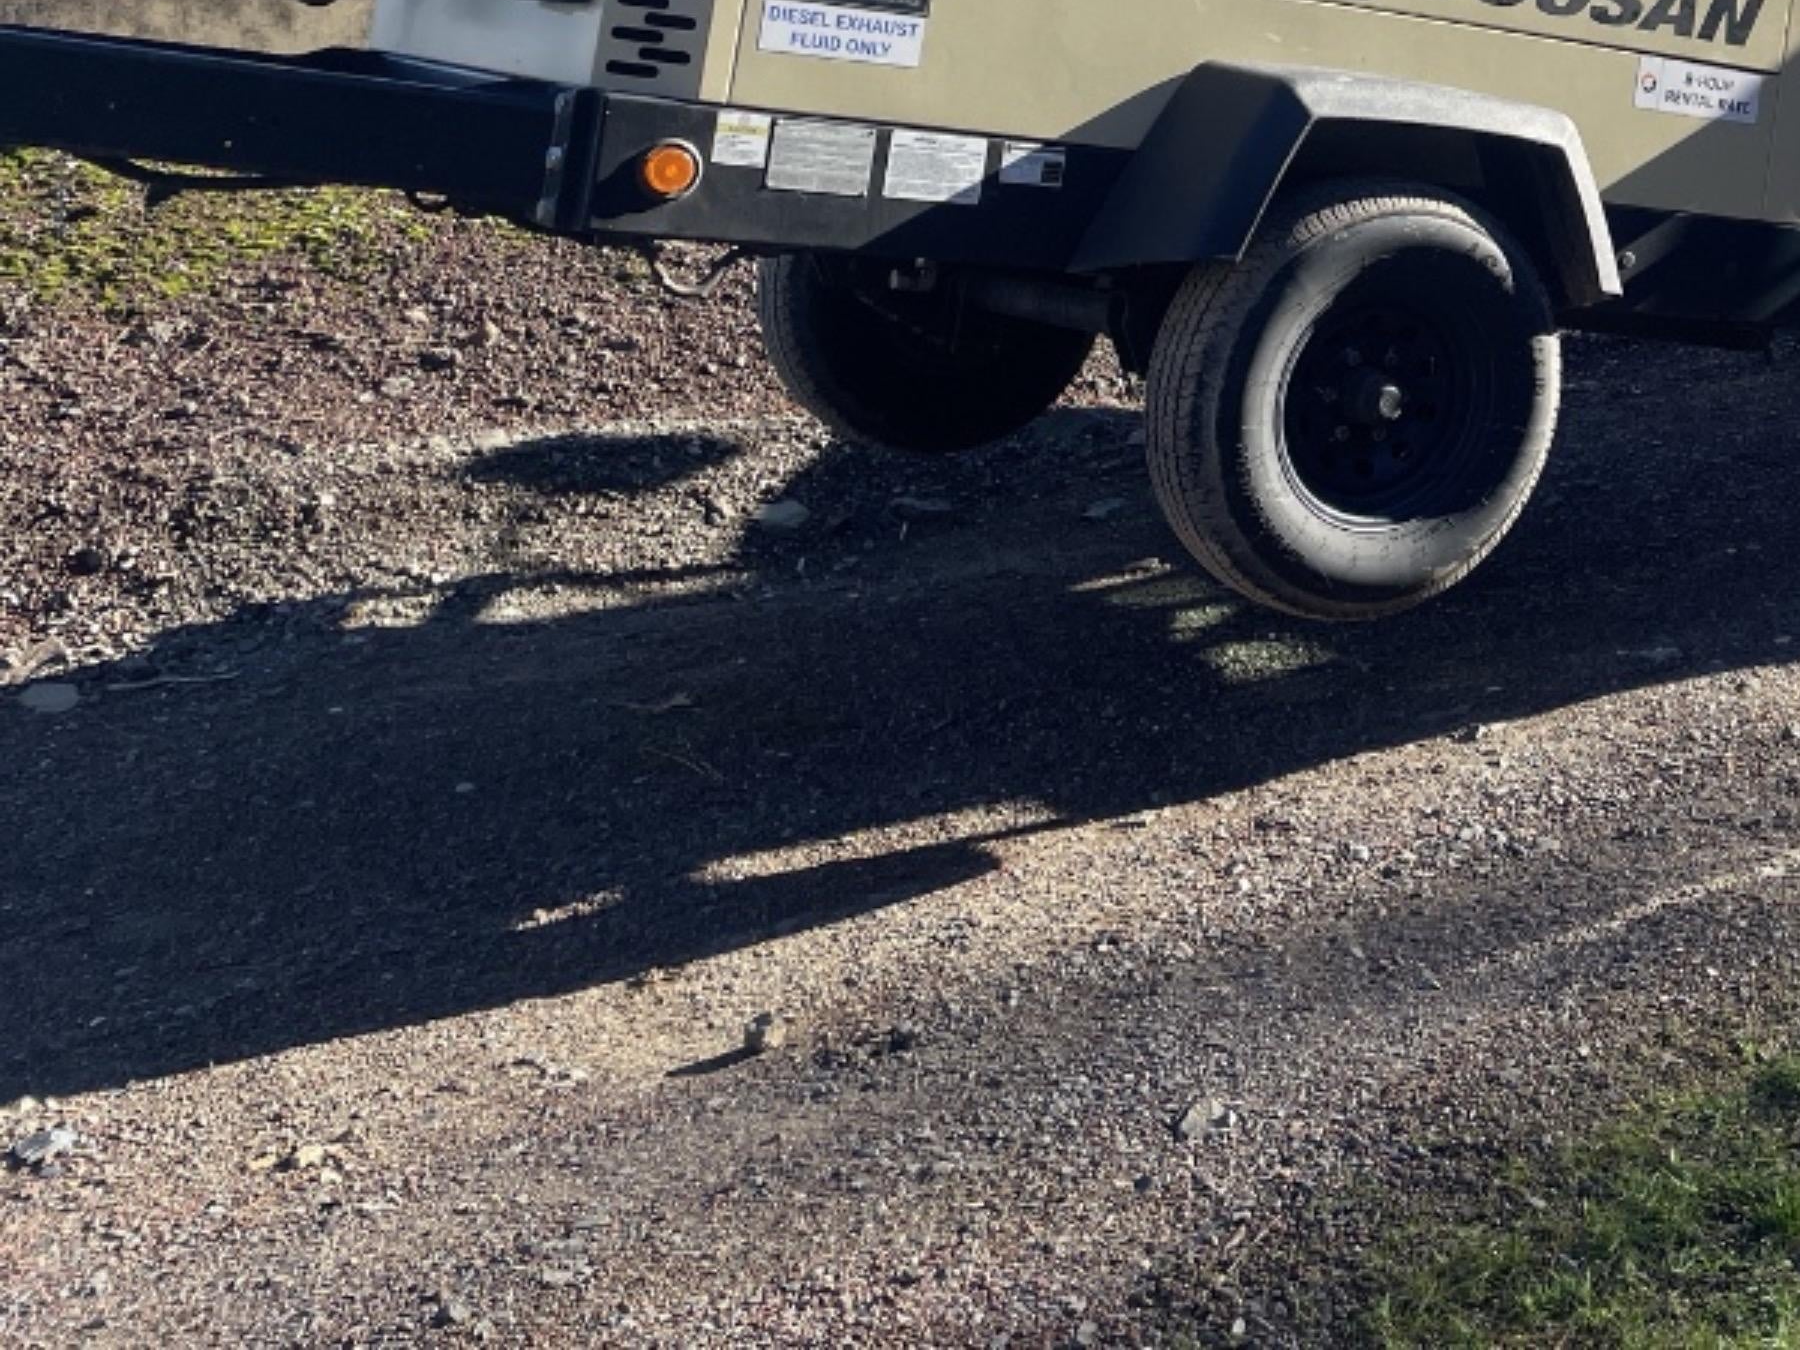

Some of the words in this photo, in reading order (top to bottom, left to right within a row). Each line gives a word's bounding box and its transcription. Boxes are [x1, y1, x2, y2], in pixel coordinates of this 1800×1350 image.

[768, 5, 831, 28] DIESEL
[836, 13, 921, 38] EXHAUST
[789, 32, 841, 52] FLUID
[845, 38, 893, 57] ONLY
[1663, 89, 1714, 109] RENTAL
